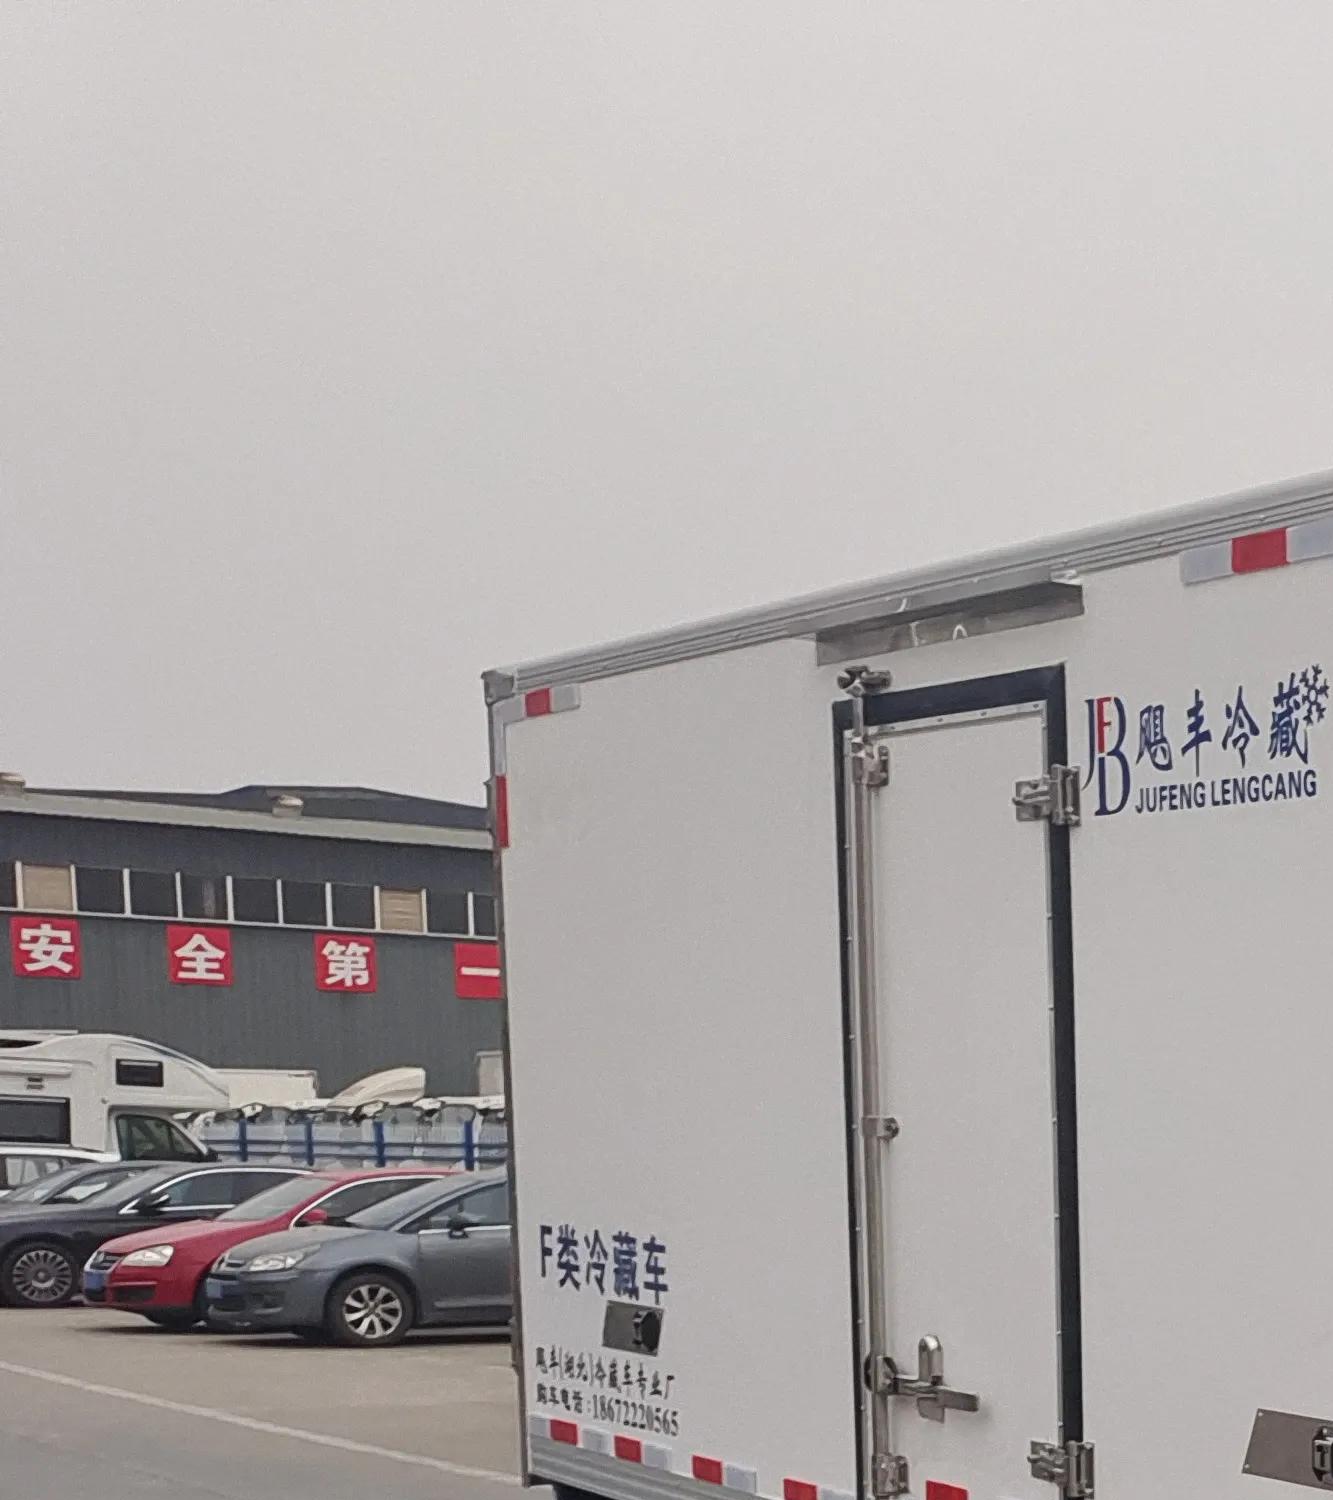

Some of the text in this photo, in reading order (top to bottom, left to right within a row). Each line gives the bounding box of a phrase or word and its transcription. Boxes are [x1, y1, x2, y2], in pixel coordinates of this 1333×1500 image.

[1135, 768, 1318, 815] JUFENG LENGCANG
[539, 1223, 669, 1305] F类冷藏车
